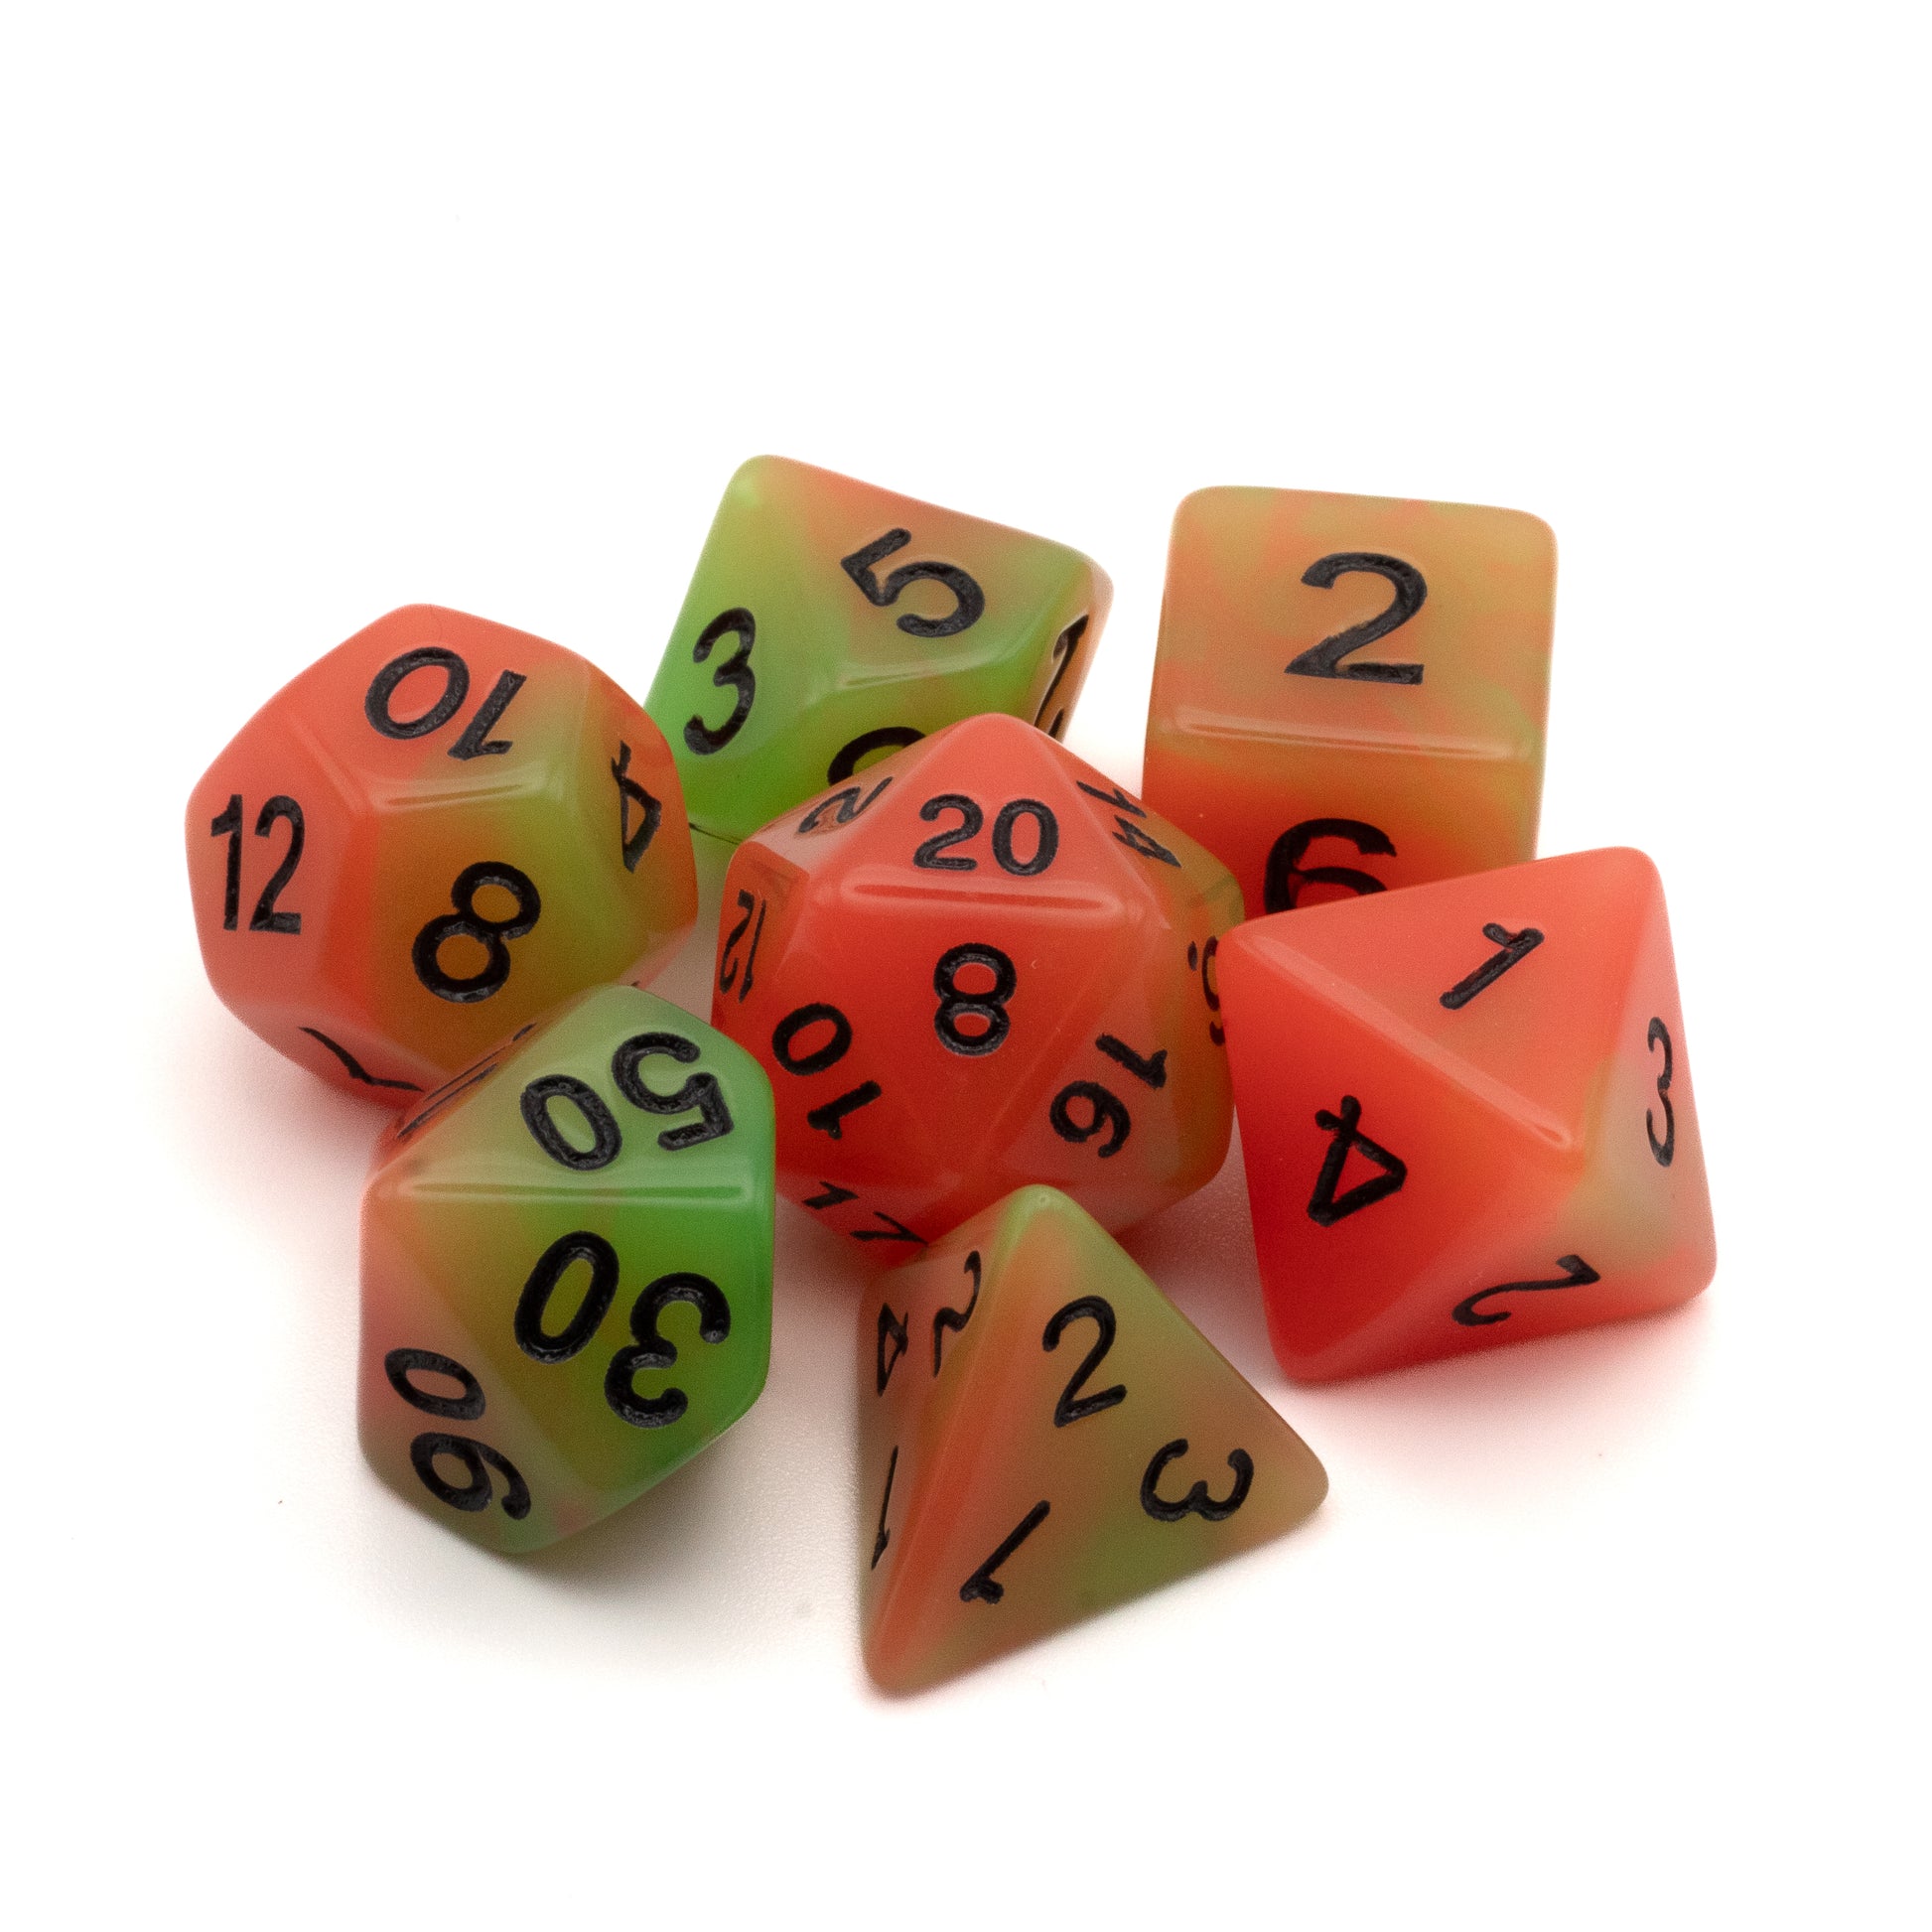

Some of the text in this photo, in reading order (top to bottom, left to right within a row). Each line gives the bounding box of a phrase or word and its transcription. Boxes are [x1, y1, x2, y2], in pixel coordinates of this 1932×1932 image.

[840, 527, 986, 638] 5
[1285, 552, 1428, 685] 2
[364, 646, 527, 760] 10
[683, 607, 757, 756] 3
[210, 794, 306, 935] 12
[611, 741, 661, 874] 4
[912, 793, 1059, 876] 20
[1263, 816, 1397, 915] 6
[411, 861, 542, 1004] 8
[719, 889, 767, 1003] 12
[1440, 922, 1545, 1011] 1
[933, 942, 1017, 1056] 8
[519, 1031, 737, 1172] 50
[771, 1002, 883, 1141] 10
[1049, 1034, 1169, 1159] 16
[1647, 1017, 1675, 1168] 3
[1307, 1095, 1408, 1227] 4
[512, 1229, 733, 1430] 30
[876, 1302, 909, 1398] 4
[1450, 1254, 1601, 1327] 2
[1042, 1295, 1128, 1429] 2
[870, 1445, 899, 1571] 1
[1139, 1438, 1255, 1523] 3
[959, 1499, 1051, 1605] 1
